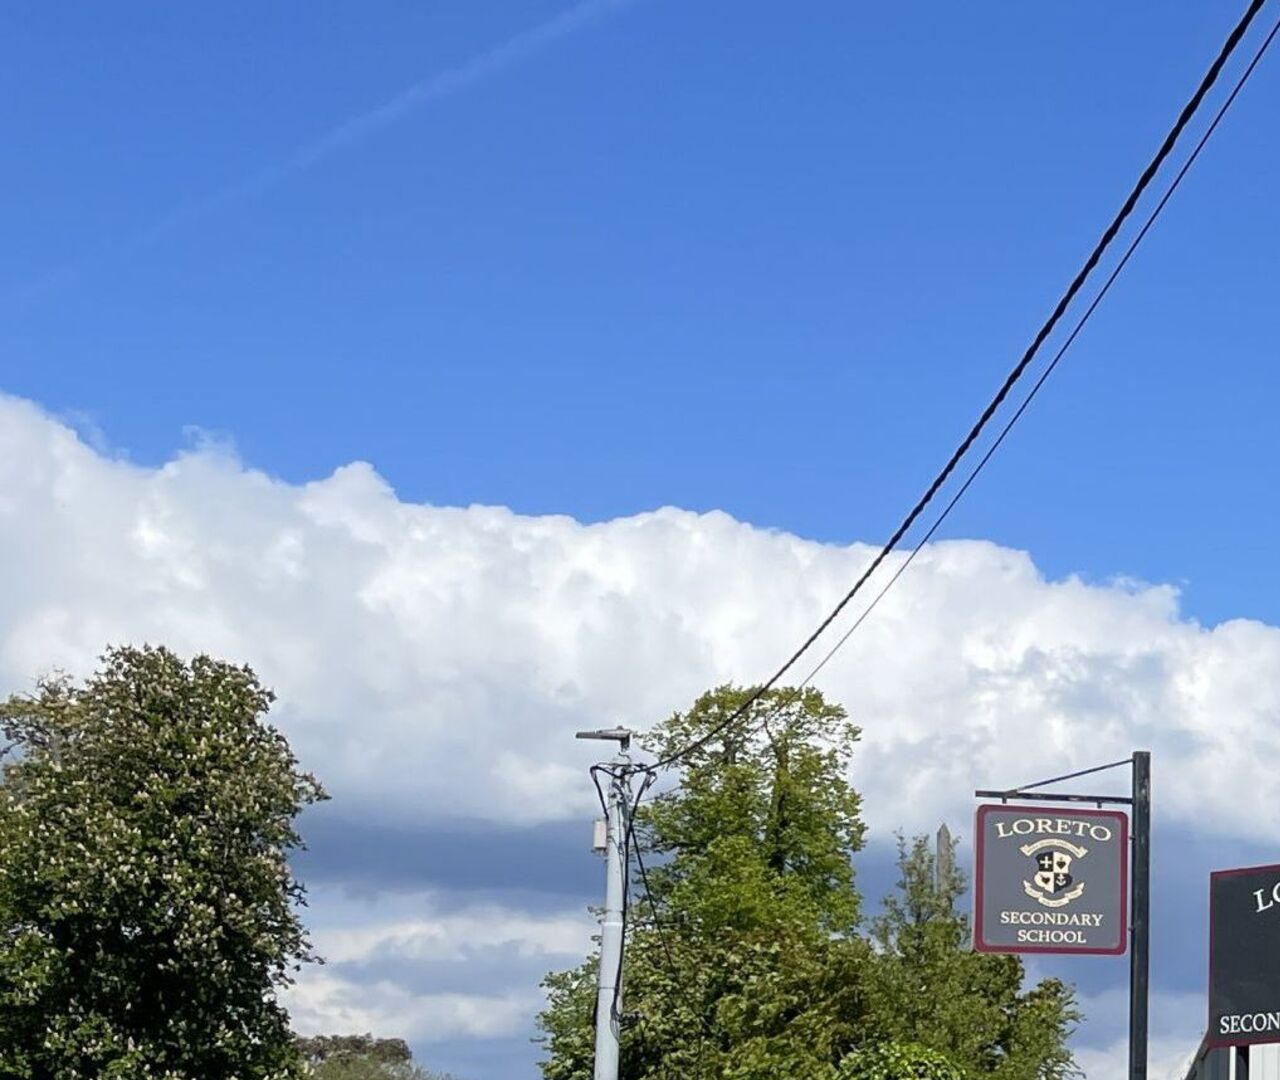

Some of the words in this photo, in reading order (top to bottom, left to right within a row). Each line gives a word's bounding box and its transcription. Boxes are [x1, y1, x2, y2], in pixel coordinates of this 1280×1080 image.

[995, 818, 1112, 841] LORETO
[1000, 911, 1104, 926] SECONDARY
[1017, 929, 1087, 943] SCHOOL
